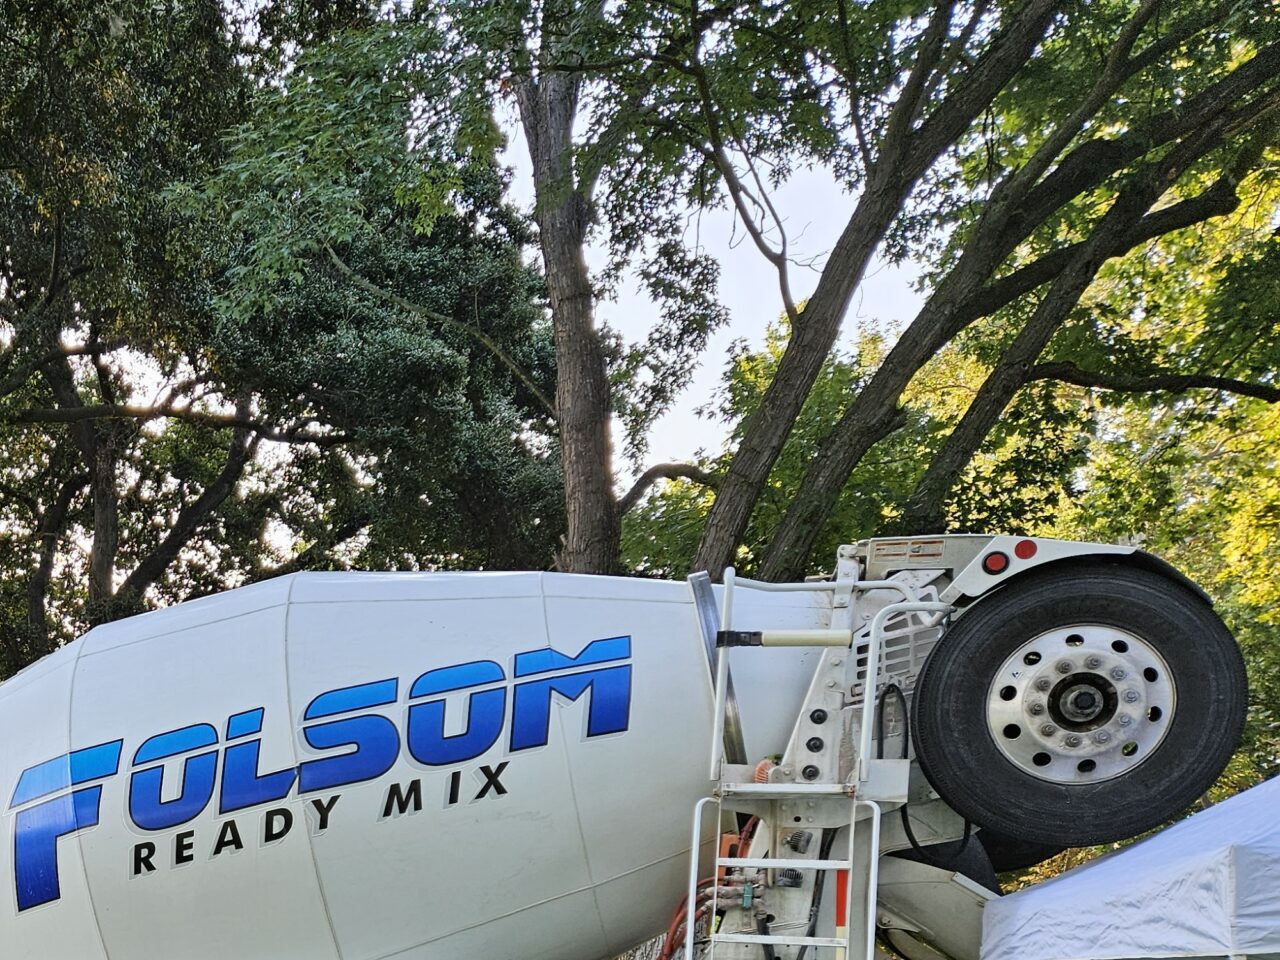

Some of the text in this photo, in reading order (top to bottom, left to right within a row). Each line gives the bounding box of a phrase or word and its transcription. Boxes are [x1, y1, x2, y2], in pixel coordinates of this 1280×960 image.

[9, 635, 632, 912] FOLSOM
[133, 761, 511, 876] READY MIX
